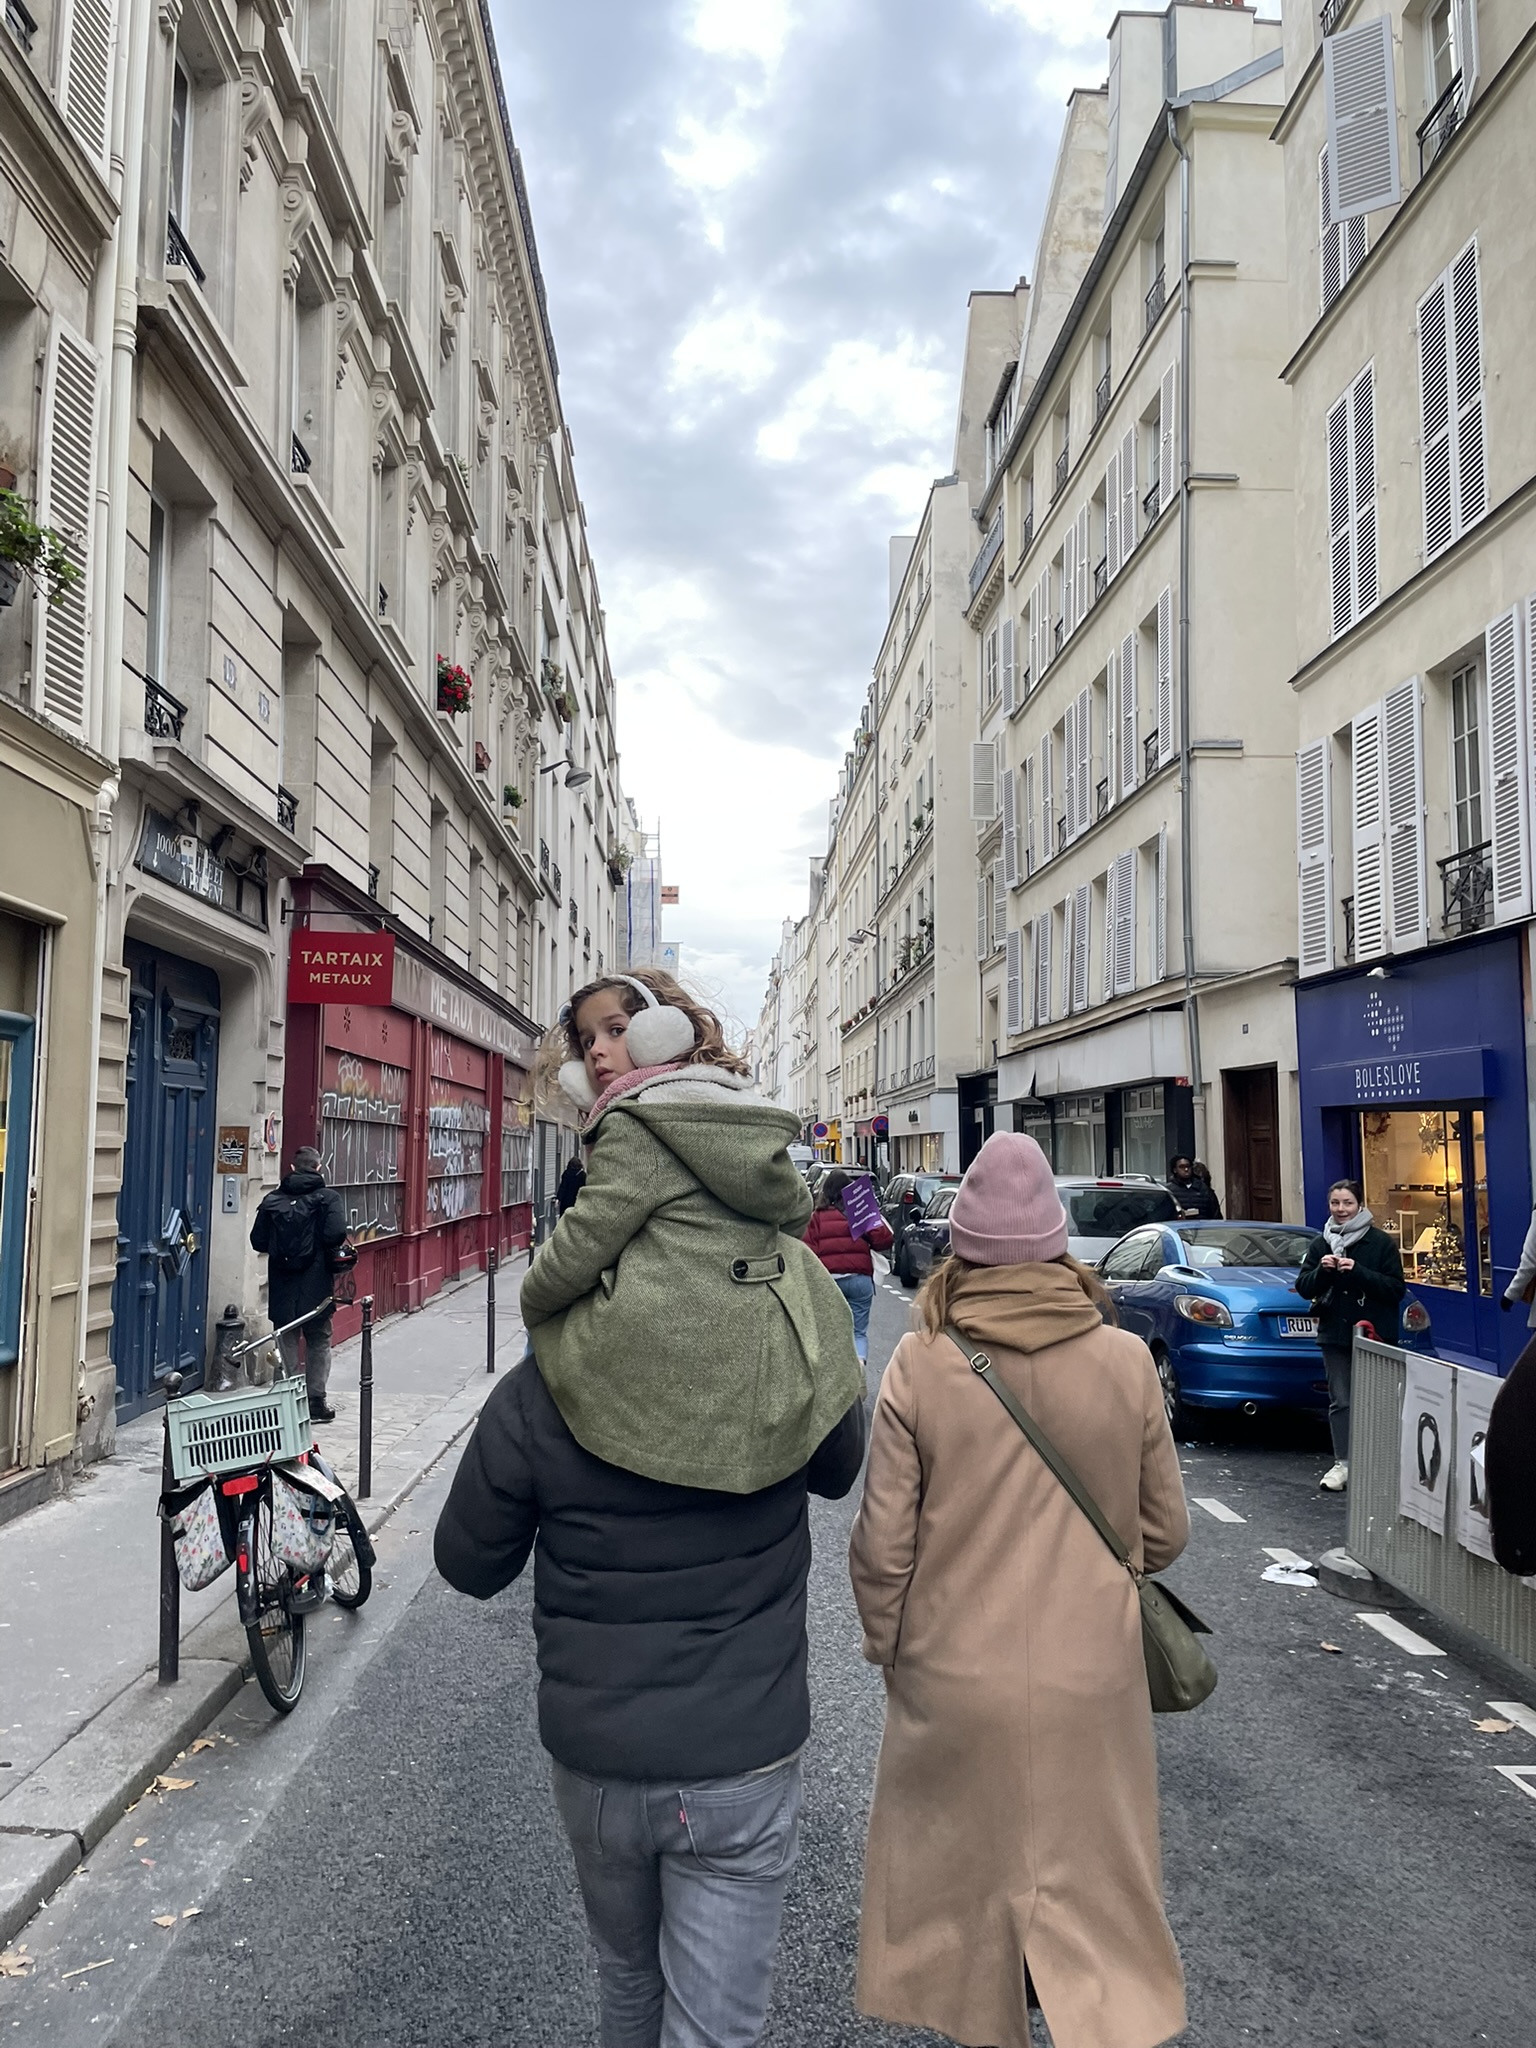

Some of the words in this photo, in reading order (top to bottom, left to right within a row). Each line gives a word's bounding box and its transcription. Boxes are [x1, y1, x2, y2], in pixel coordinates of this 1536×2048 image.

[156, 832, 177, 858] 1000
[301, 950, 383, 967] TARTAIX
[309, 972, 372, 985] METAUX
[430, 978, 473, 1034] METAUX
[479, 1009, 521, 1059] OUTILLAGE
[1355, 1062, 1421, 1089] BOLESLOVE
[1287, 1318, 1313, 1333] RÜD
